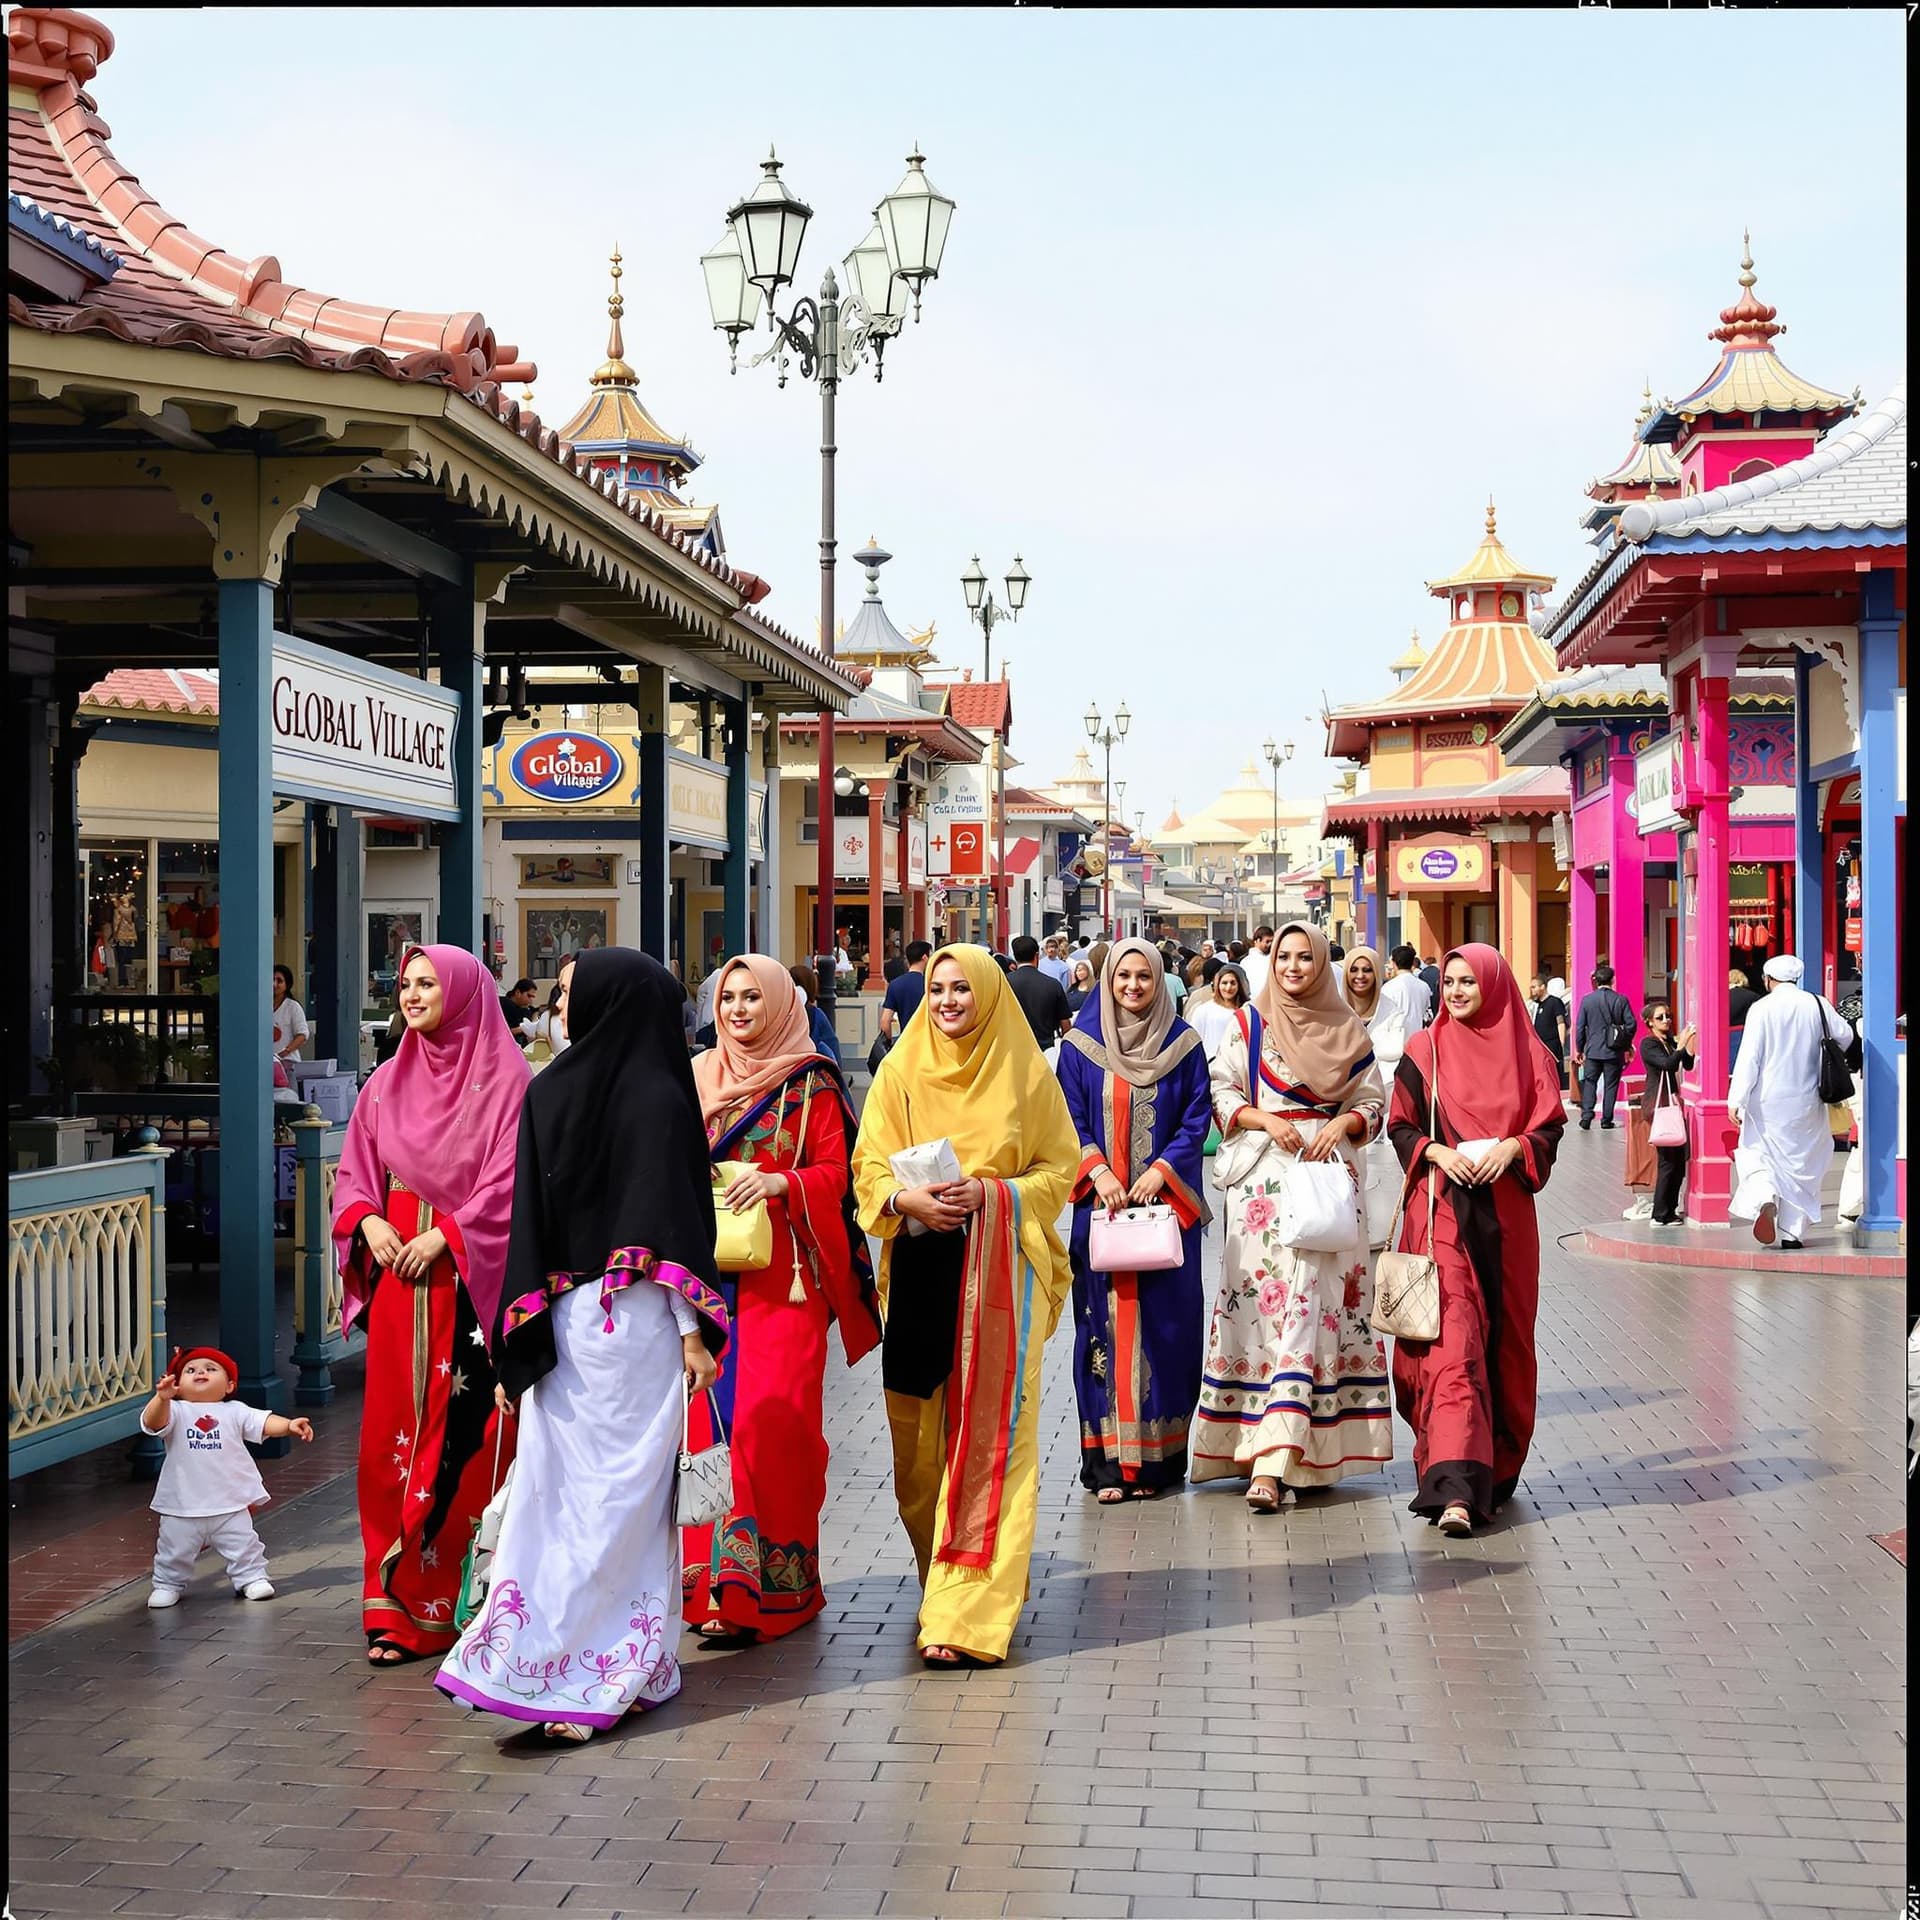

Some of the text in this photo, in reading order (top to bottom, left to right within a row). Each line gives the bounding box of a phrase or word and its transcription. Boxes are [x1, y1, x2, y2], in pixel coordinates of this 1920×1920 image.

[272, 676, 445, 770] GLOBAL VILLAGE
[529, 754, 602, 775] Global
